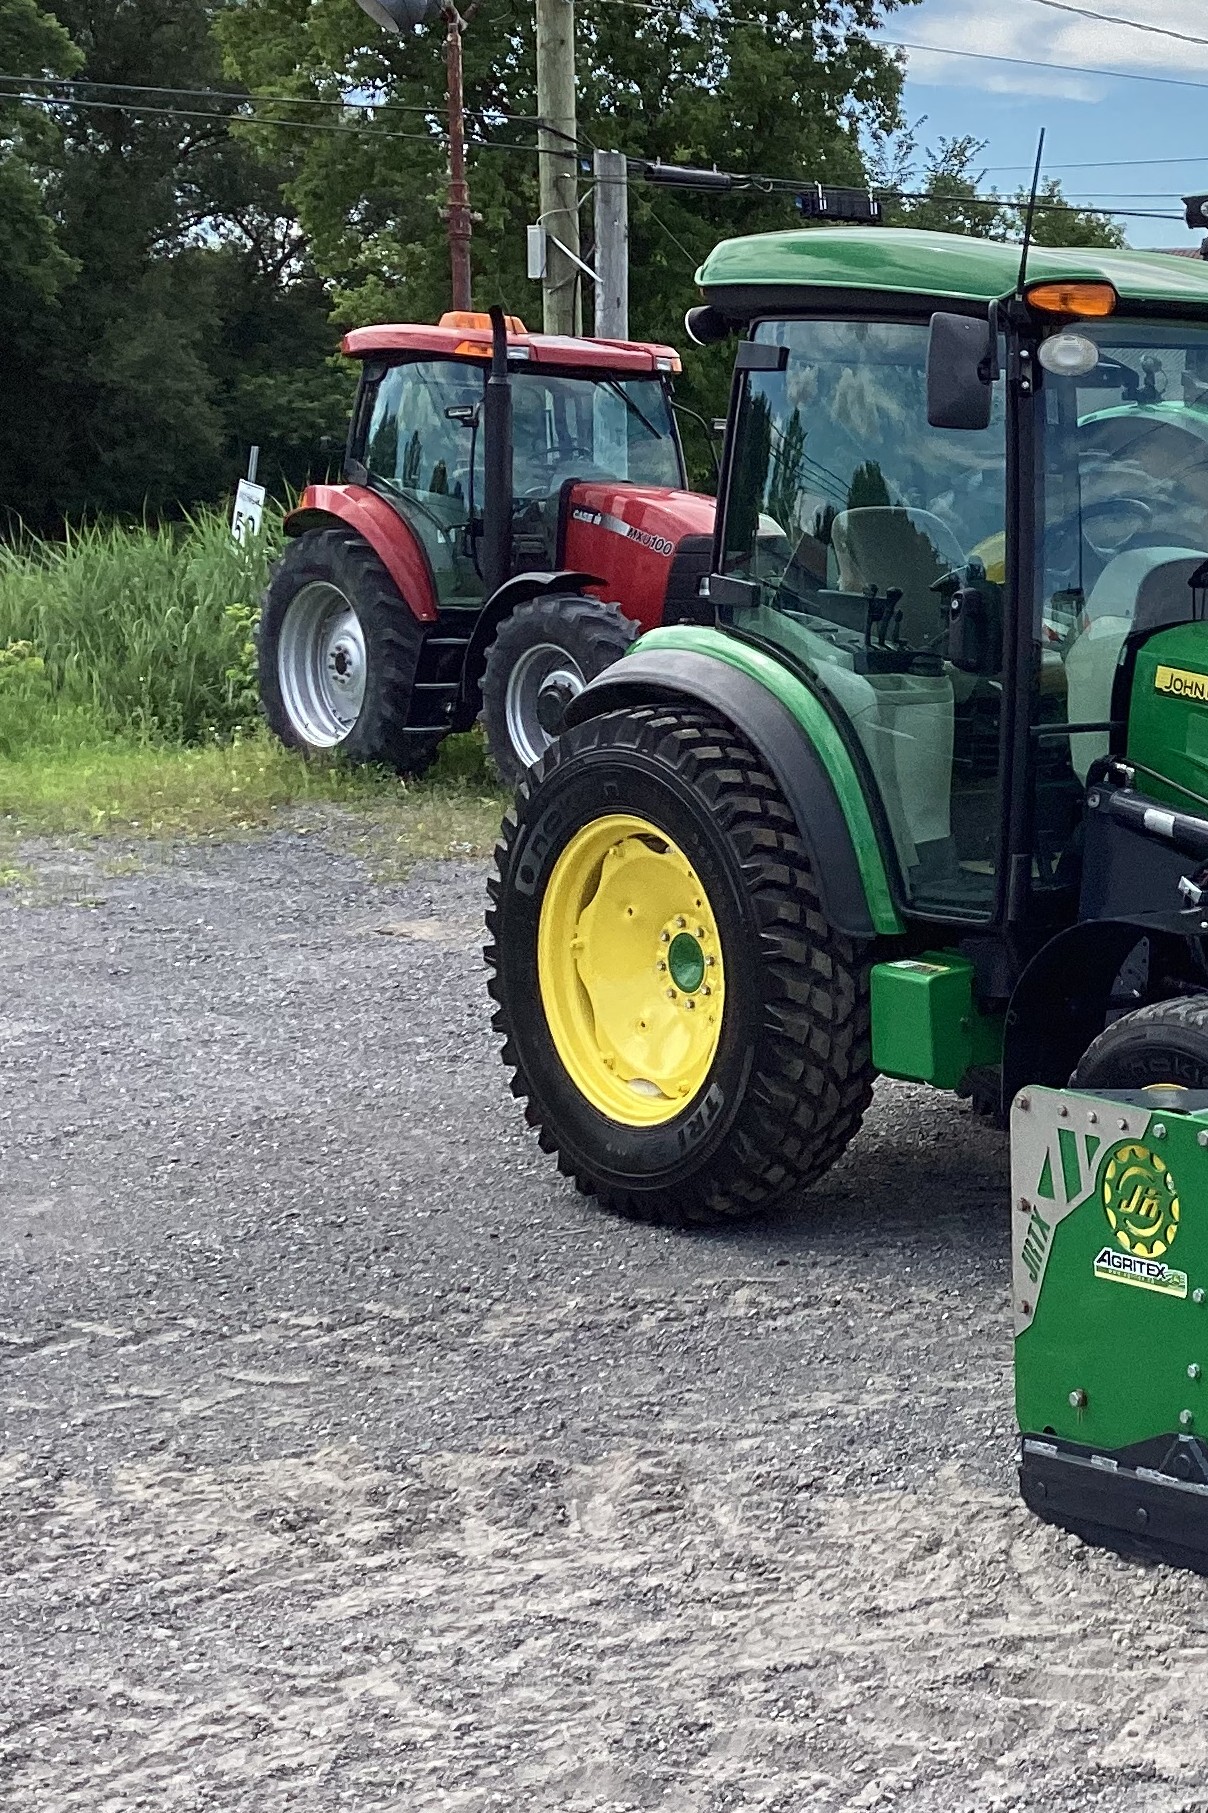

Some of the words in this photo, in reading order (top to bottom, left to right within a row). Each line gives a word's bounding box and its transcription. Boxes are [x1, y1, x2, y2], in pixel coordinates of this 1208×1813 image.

[626, 526, 674, 556] MXU100
[1164, 673, 1205, 698] JOHN
[1021, 1204, 1051, 1285] JRTX
[1096, 1249, 1166, 1280] AGRITEX
